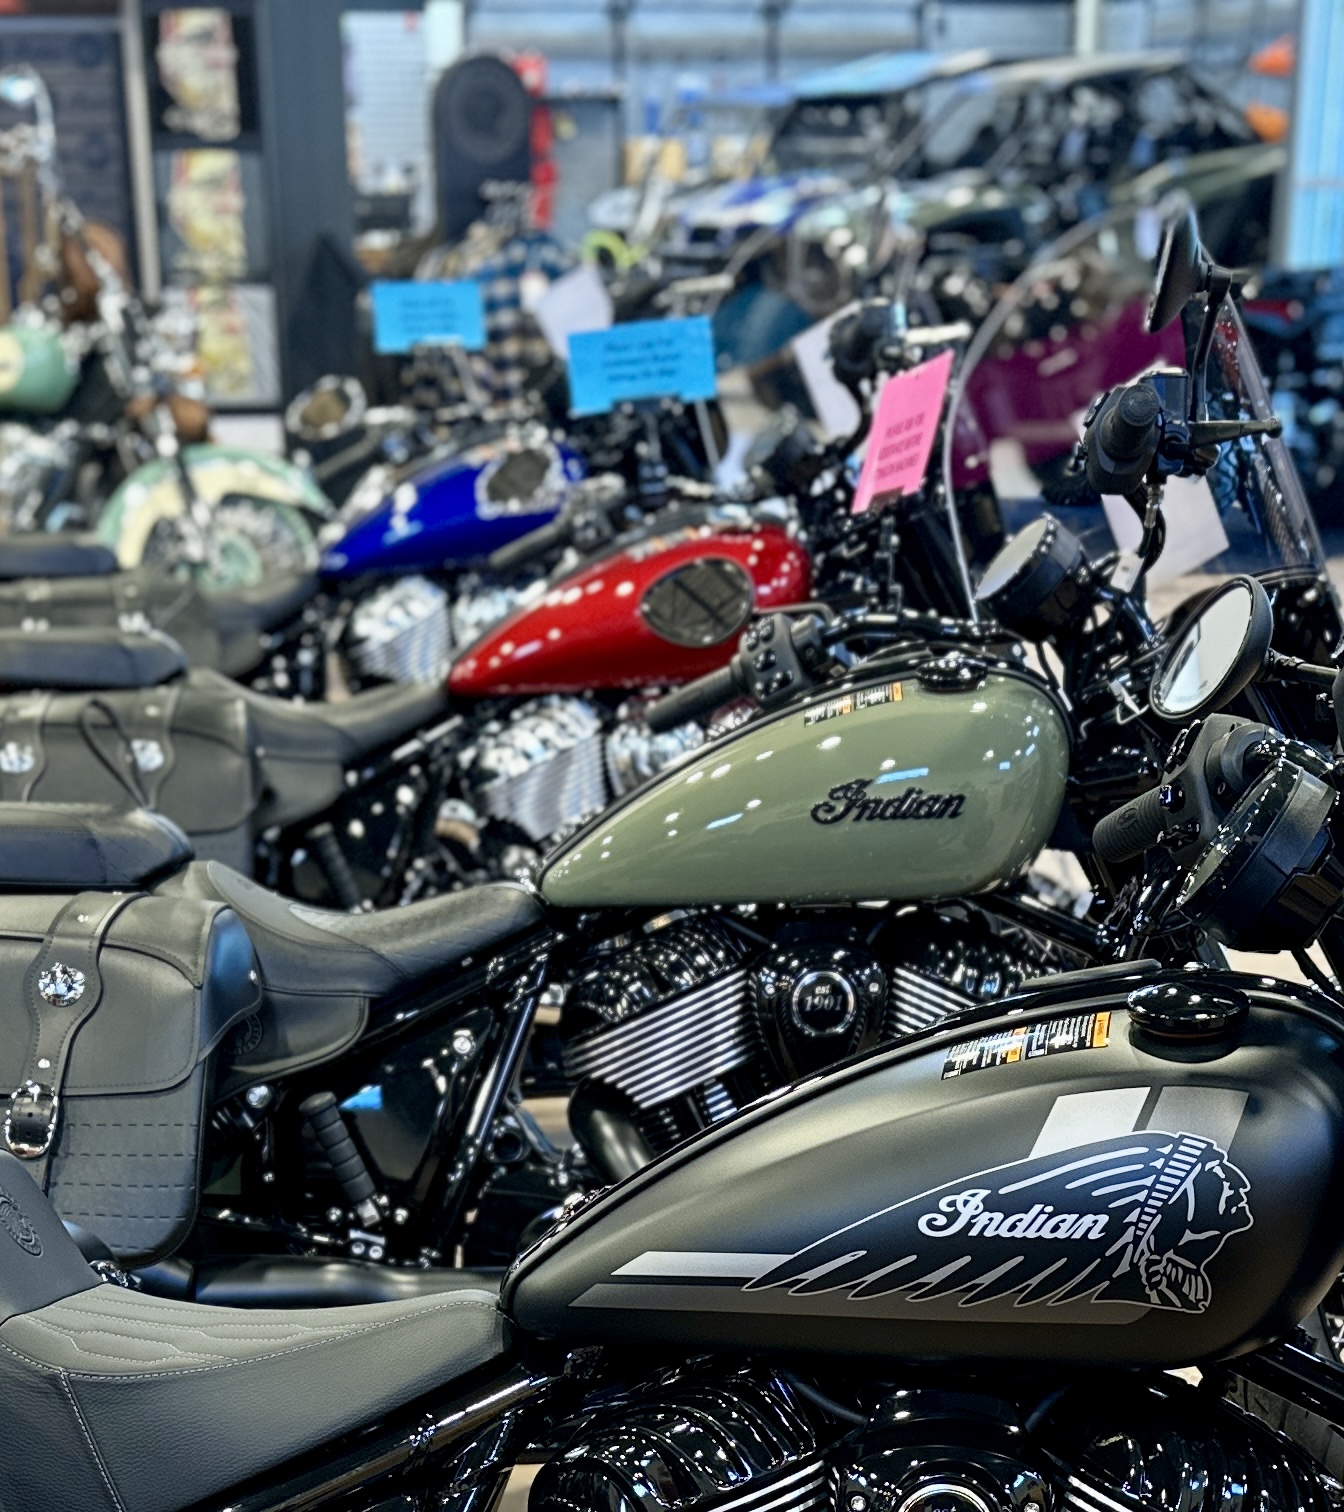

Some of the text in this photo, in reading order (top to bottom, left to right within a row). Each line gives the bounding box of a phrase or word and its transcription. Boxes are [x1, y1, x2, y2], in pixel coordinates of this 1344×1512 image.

[810, 778, 967, 825] Indian
[804, 995, 843, 1011] 1901
[917, 1188, 1110, 1240] Indian
